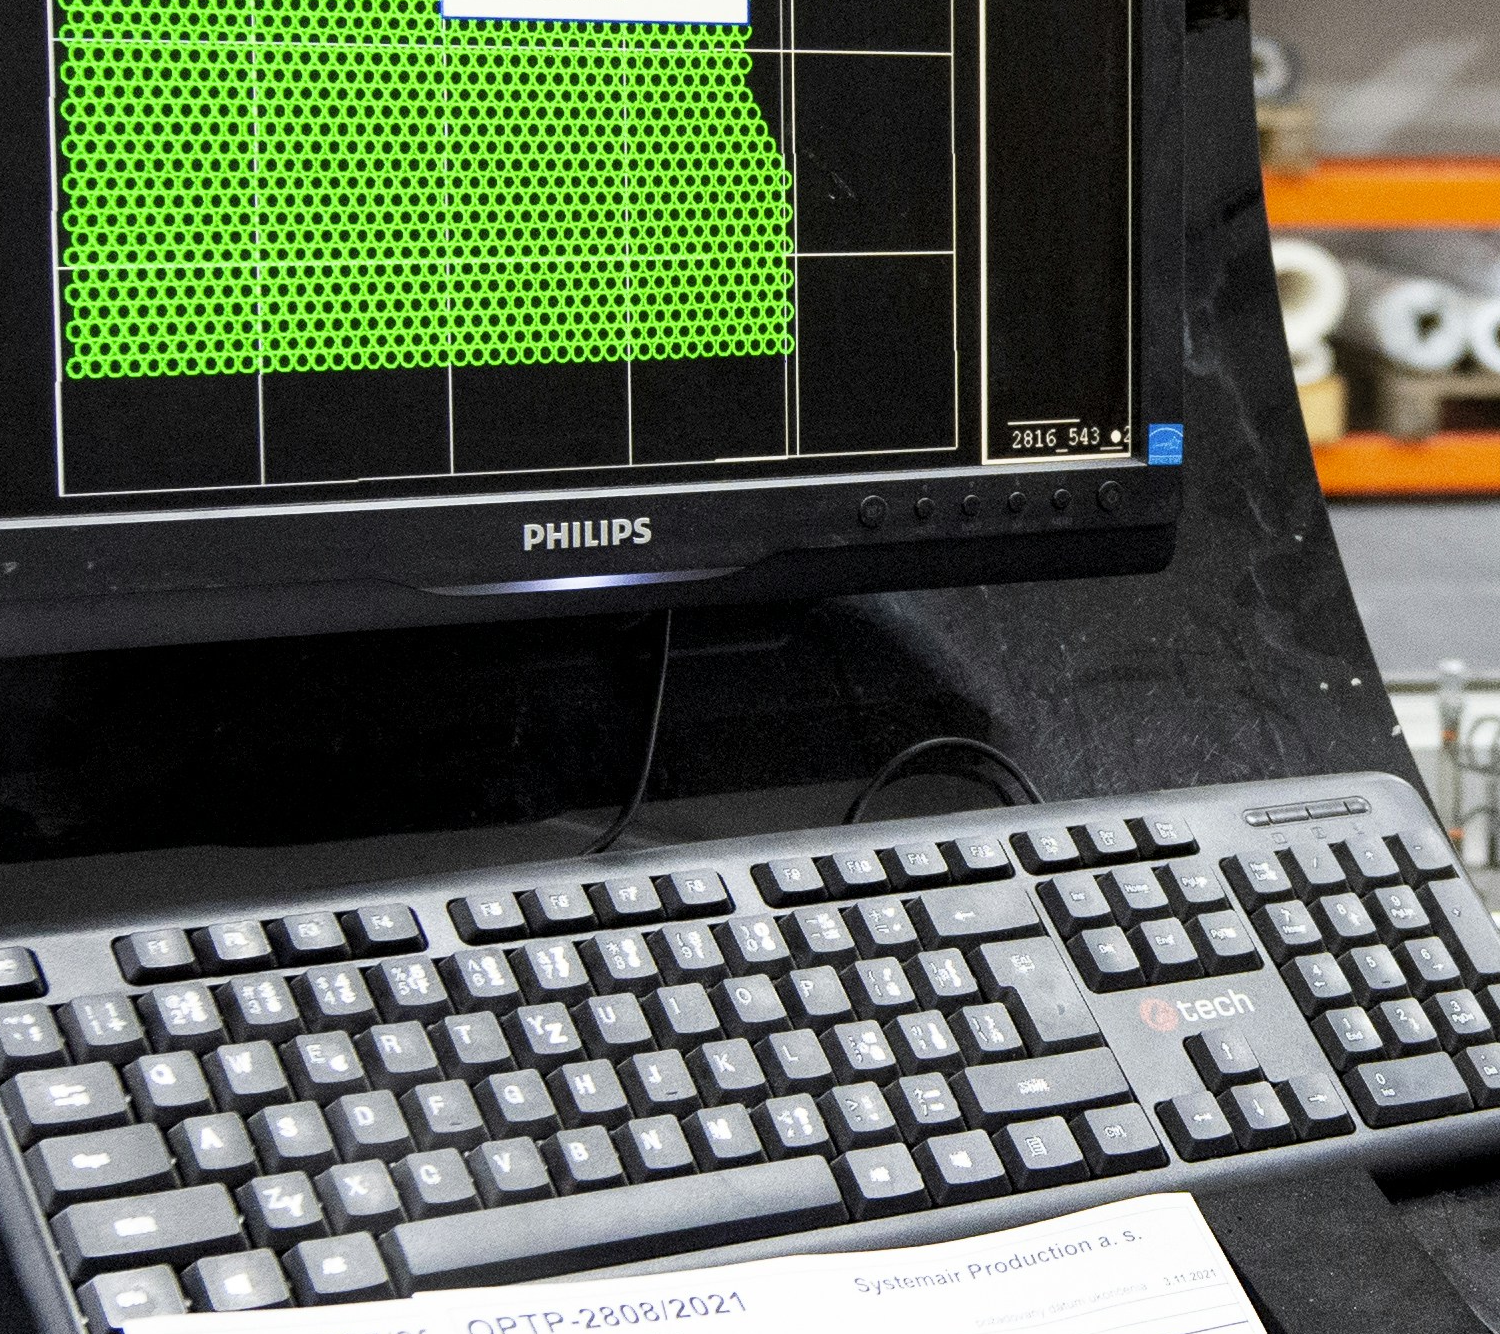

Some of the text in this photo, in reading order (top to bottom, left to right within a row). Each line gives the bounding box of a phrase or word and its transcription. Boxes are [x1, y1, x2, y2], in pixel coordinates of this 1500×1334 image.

[523, 517, 652, 551] PHILIPS
[1366, 956, 1377, 968] 5
[735, 987, 752, 1005] O
[599, 1006, 616, 1024] U
[379, 1034, 402, 1055] R
[454, 1024, 472, 1045] T
[226, 1050, 253, 1075] W
[305, 1043, 325, 1064] E
[711, 1053, 736, 1073] K
[783, 1044, 800, 1063] L
[573, 1073, 596, 1095] H
[646, 1063, 663, 1085] J
[353, 1106, 375, 1127] D
[428, 1097, 446, 1117] F
[200, 1127, 223, 1149] A
[275, 1118, 299, 1138] S
[640, 1129, 663, 1150] N
[567, 1141, 590, 1162] B
[492, 1152, 512, 1173] V
[344, 1175, 370, 1197] X
[854, 1228, 1143, 1296] Systemair Production a. s.
